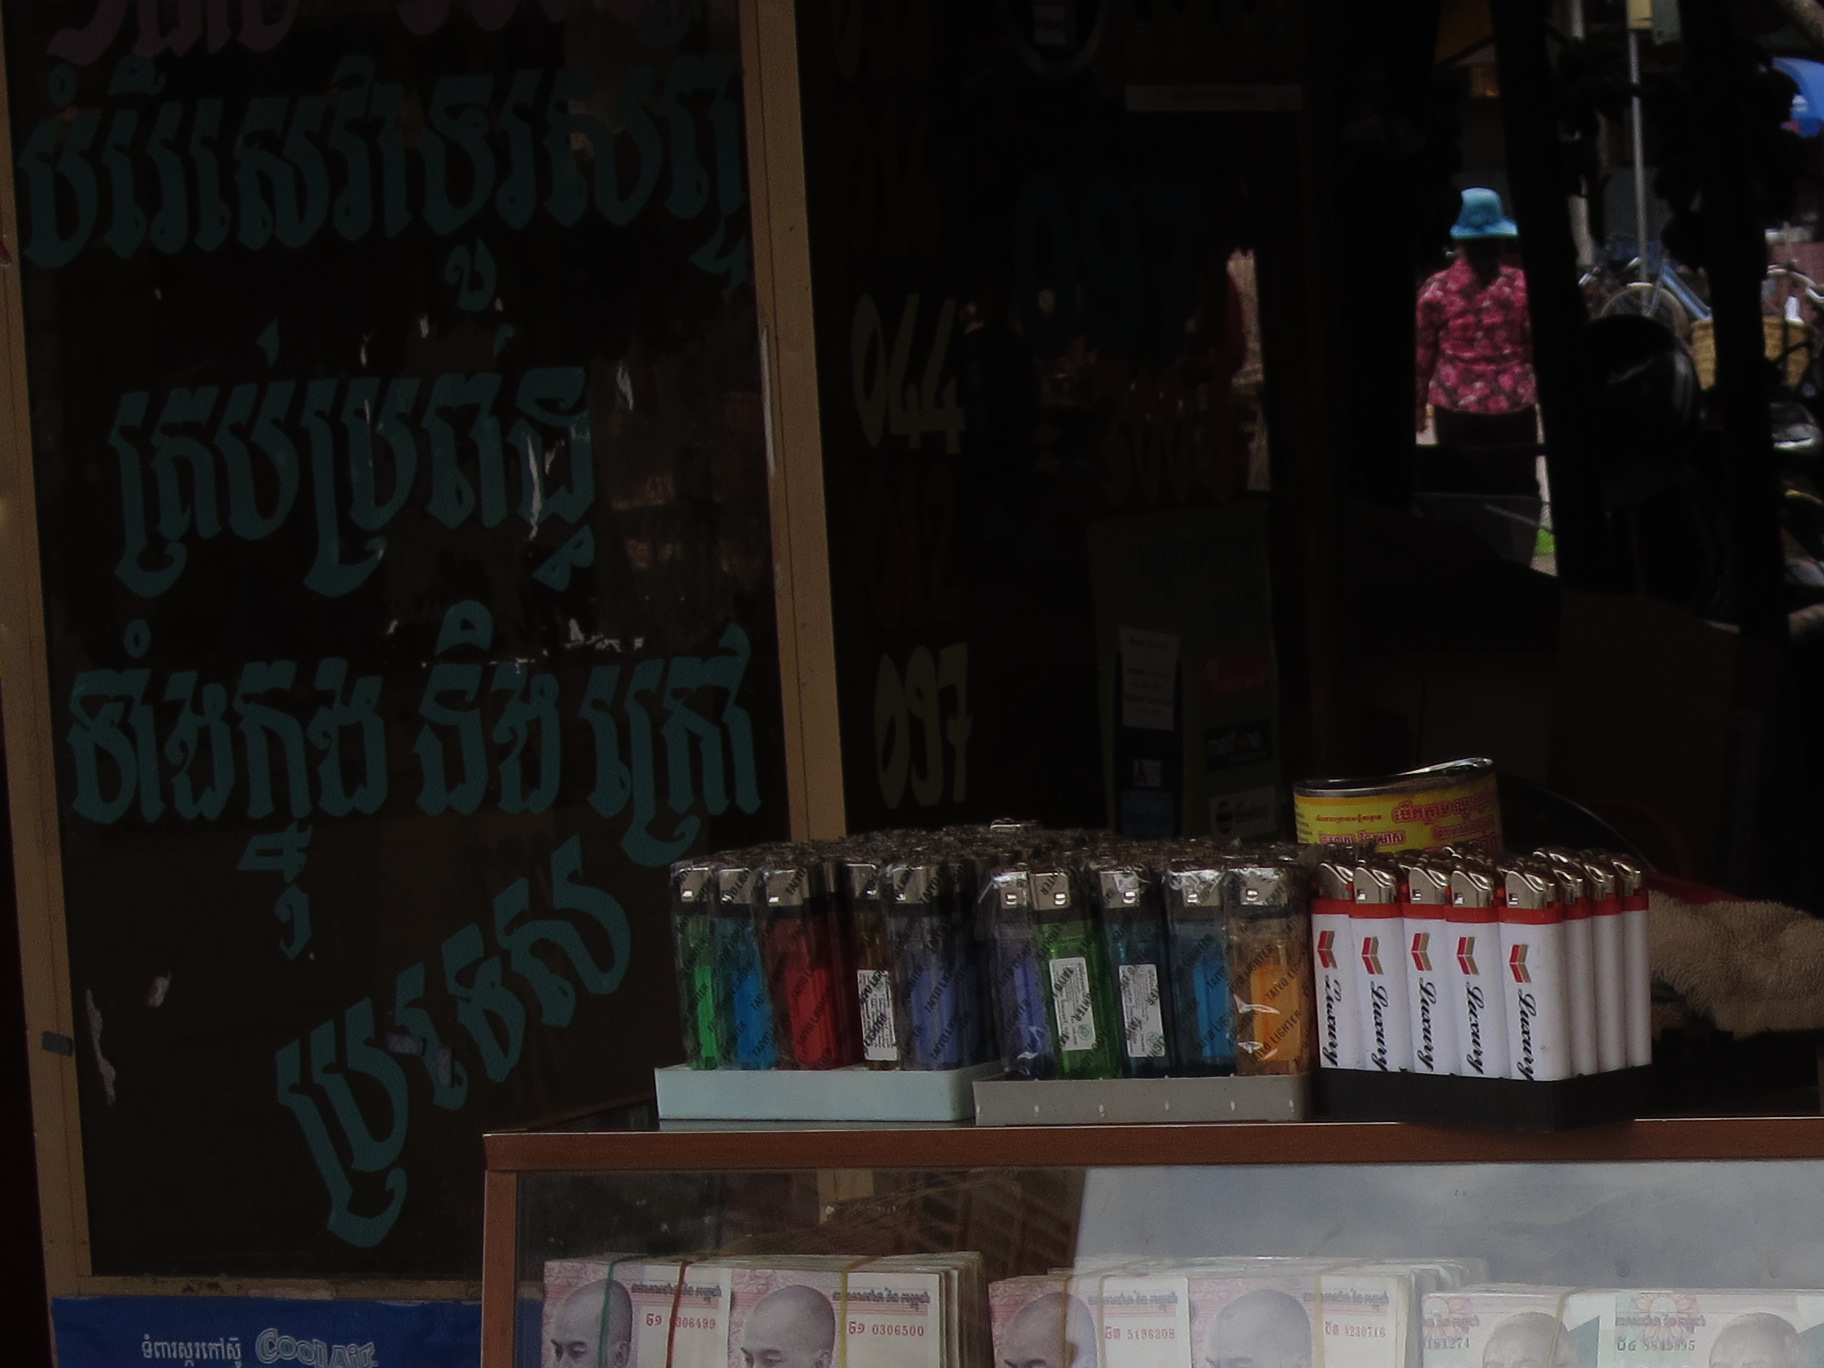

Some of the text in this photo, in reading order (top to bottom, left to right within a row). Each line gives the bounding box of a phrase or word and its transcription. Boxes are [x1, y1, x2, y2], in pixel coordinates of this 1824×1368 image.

[852, 293, 965, 458] 044
[874, 641, 972, 812] 097
[1265, 978, 1288, 1001] TAIYO
[1270, 1010, 1301, 1044] LIGHTER
[1320, 975, 1342, 1067] Luxury
[1371, 980, 1388, 1073] Luxury
[1417, 977, 1438, 1073] Luxury
[1465, 979, 1484, 1076] Luxury
[1517, 988, 1538, 1082] Luxury
[872, 1323, 925, 1338] 0306500
